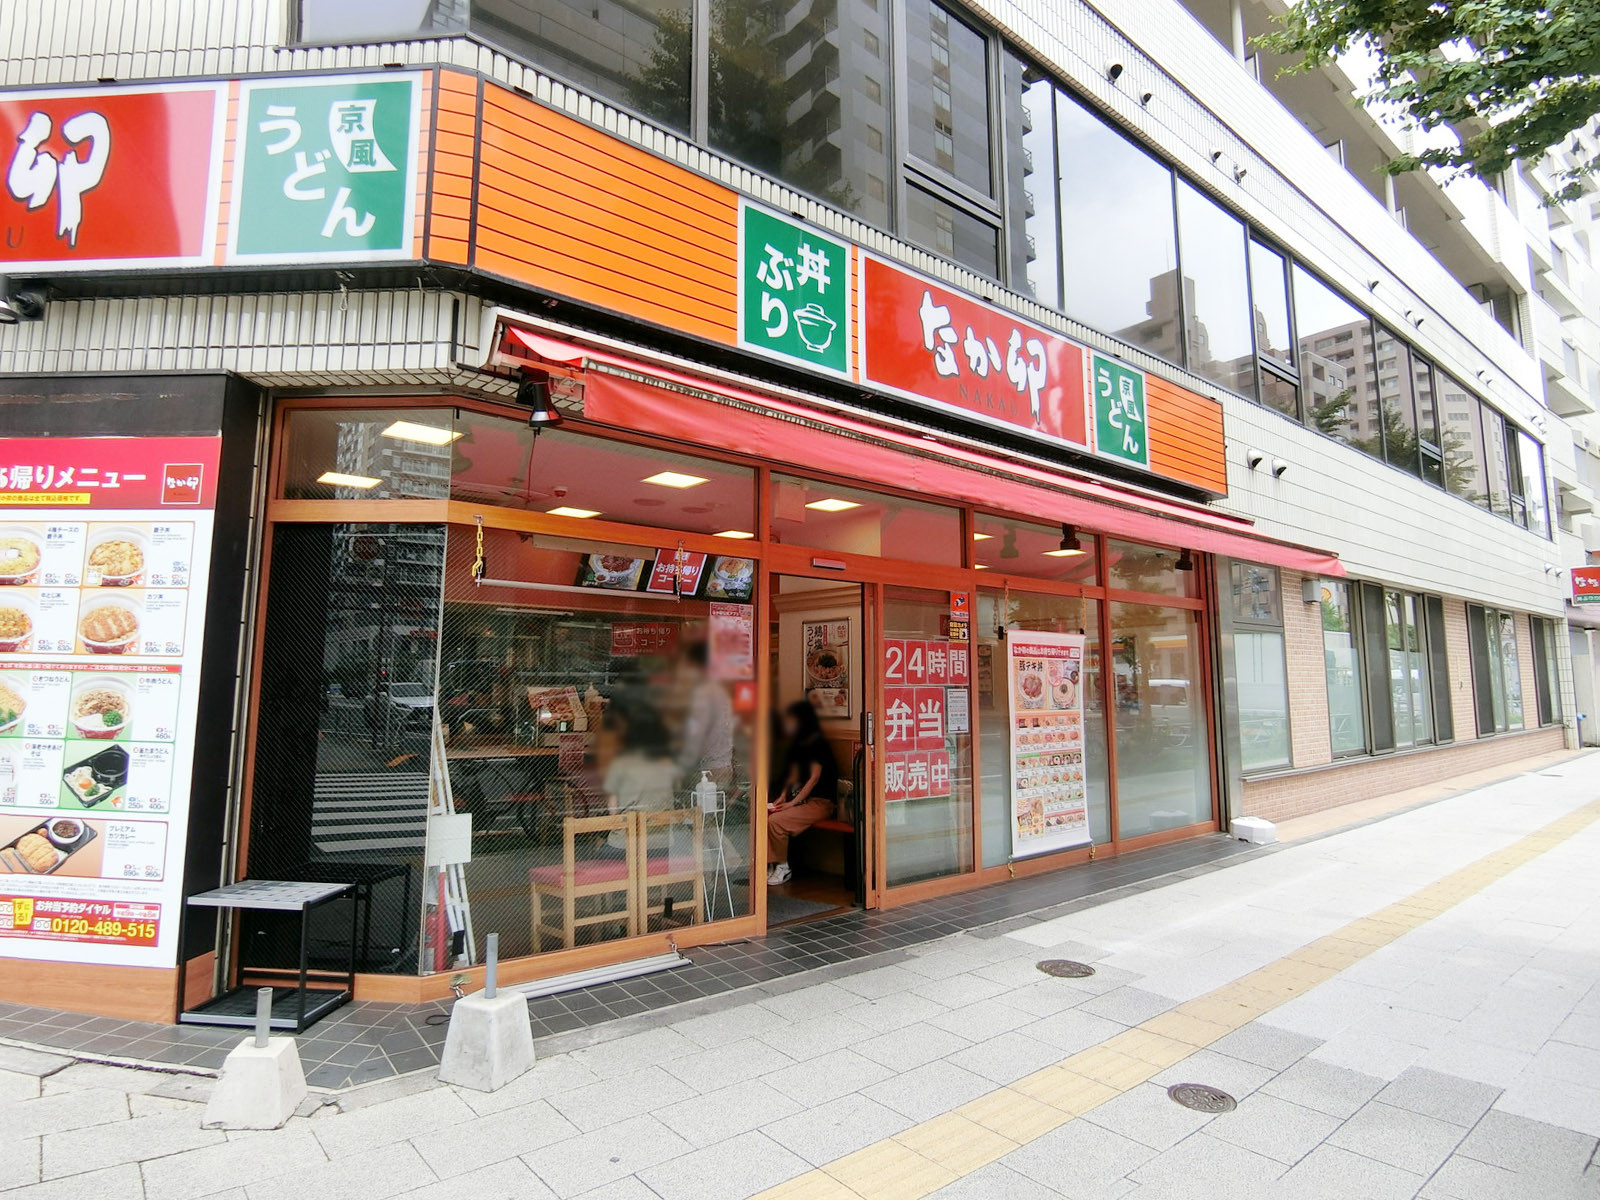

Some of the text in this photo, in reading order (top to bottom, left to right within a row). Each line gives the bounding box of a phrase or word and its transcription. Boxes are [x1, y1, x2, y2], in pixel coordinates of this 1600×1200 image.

[336, 104, 377, 168] 京風
[259, 104, 376, 239] うどん
[756, 242, 832, 339] 丼ぶり
[918, 289, 1048, 426] なか卯
[958, 383, 1020, 418] NAKAU
[1096, 366, 1140, 456] うどん
[1119, 377, 1137, 417] 京風
[657, 574, 693, 583] コーー
[806, 626, 815, 657] うどん
[884, 645, 968, 678] 24時間
[884, 697, 944, 743] 弁当
[884, 758, 950, 793] 販売中
[51, 917, 156, 938] 0120-489-515
